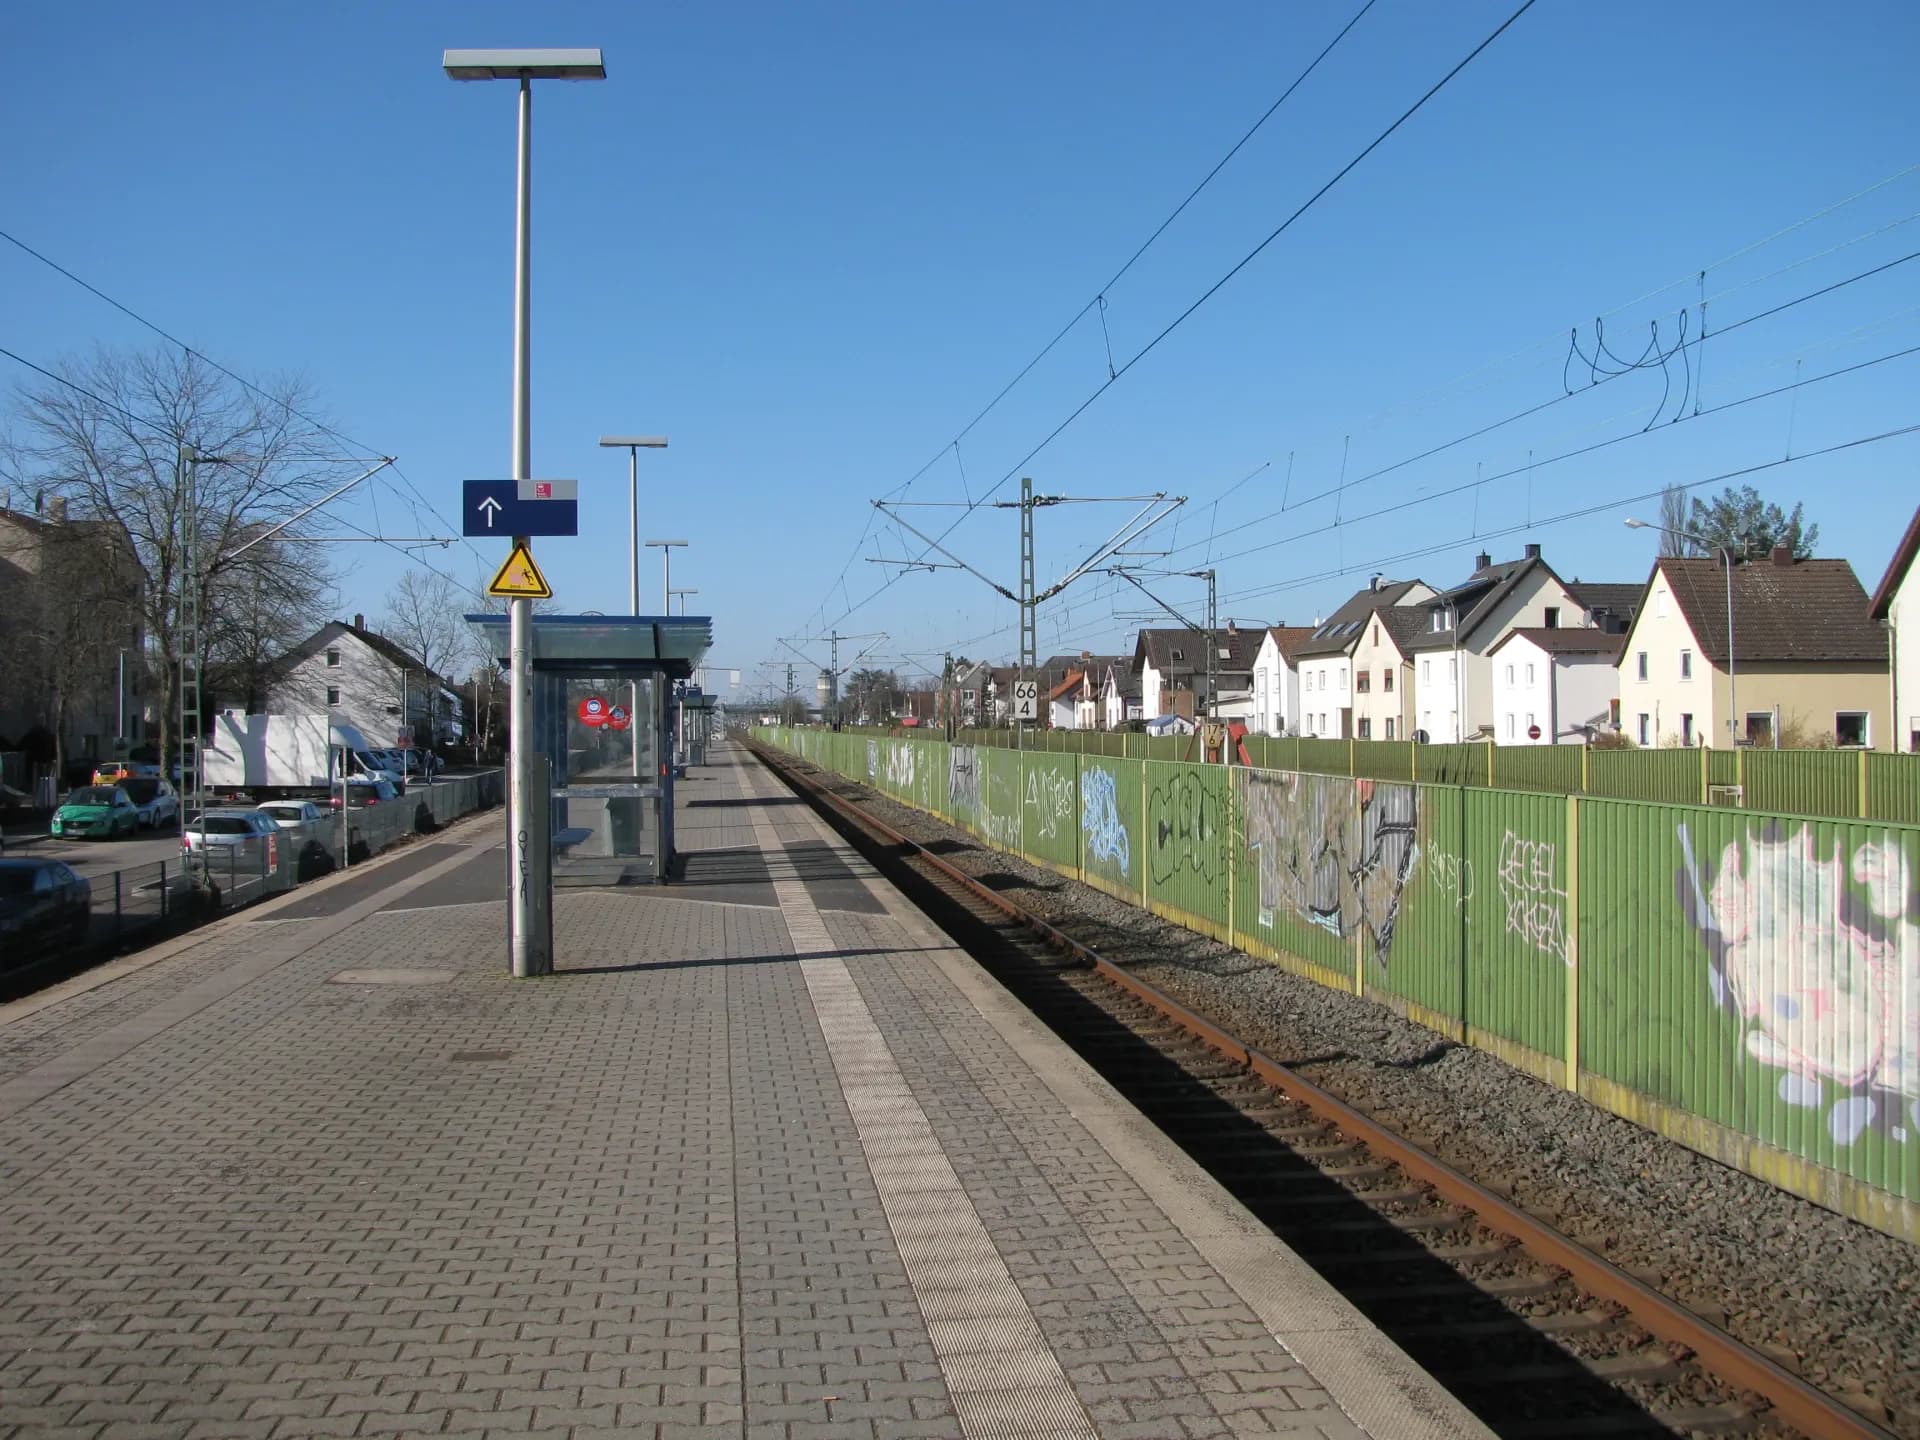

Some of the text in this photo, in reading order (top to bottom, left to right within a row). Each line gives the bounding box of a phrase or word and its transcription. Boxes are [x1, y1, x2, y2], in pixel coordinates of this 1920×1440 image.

[1016, 683, 1036, 698] 66
[1020, 701, 1030, 716] 4
[1208, 725, 1217, 734] 17
[1209, 735, 1215, 744] 6
